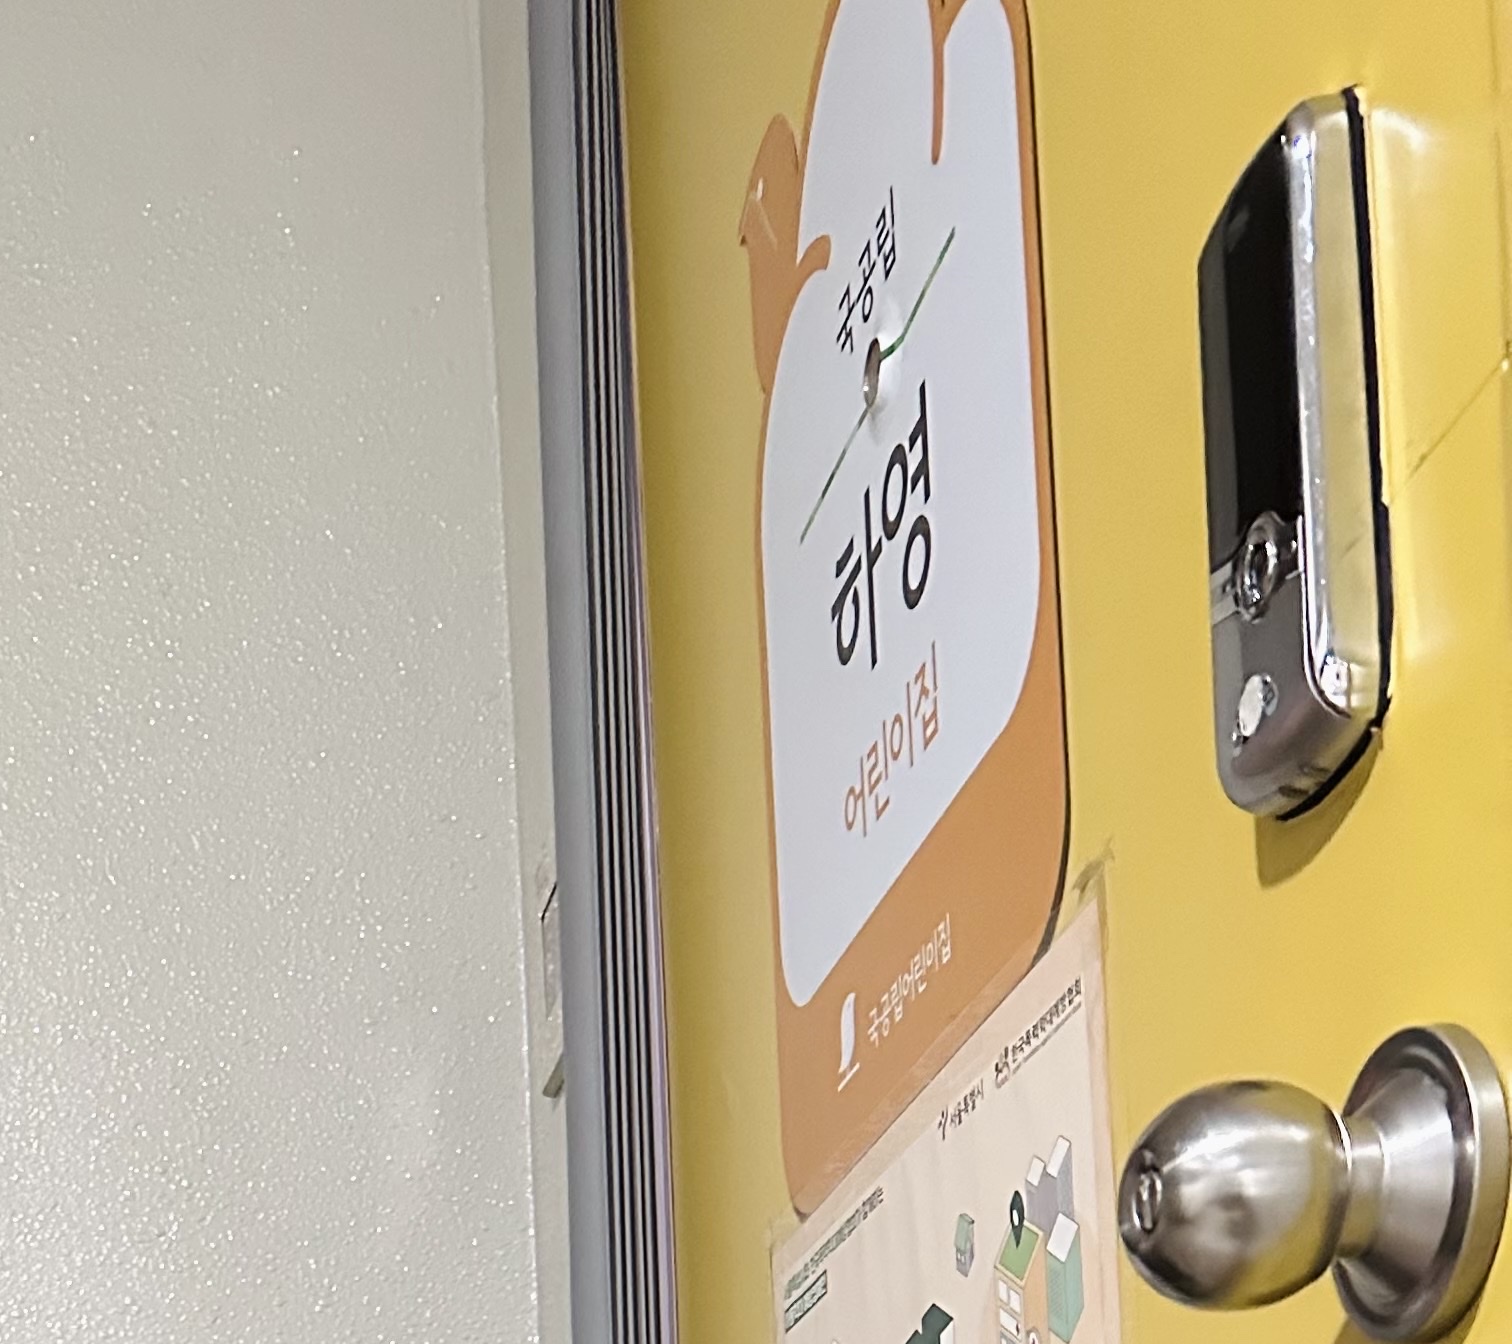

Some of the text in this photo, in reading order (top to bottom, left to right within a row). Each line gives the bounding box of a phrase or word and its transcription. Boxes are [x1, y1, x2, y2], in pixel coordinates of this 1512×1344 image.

[835, 186, 897, 355] 국공립
[831, 379, 931, 671] 하영
[843, 641, 940, 838] 어린이집
[868, 912, 952, 1048] 국공립어린이집
